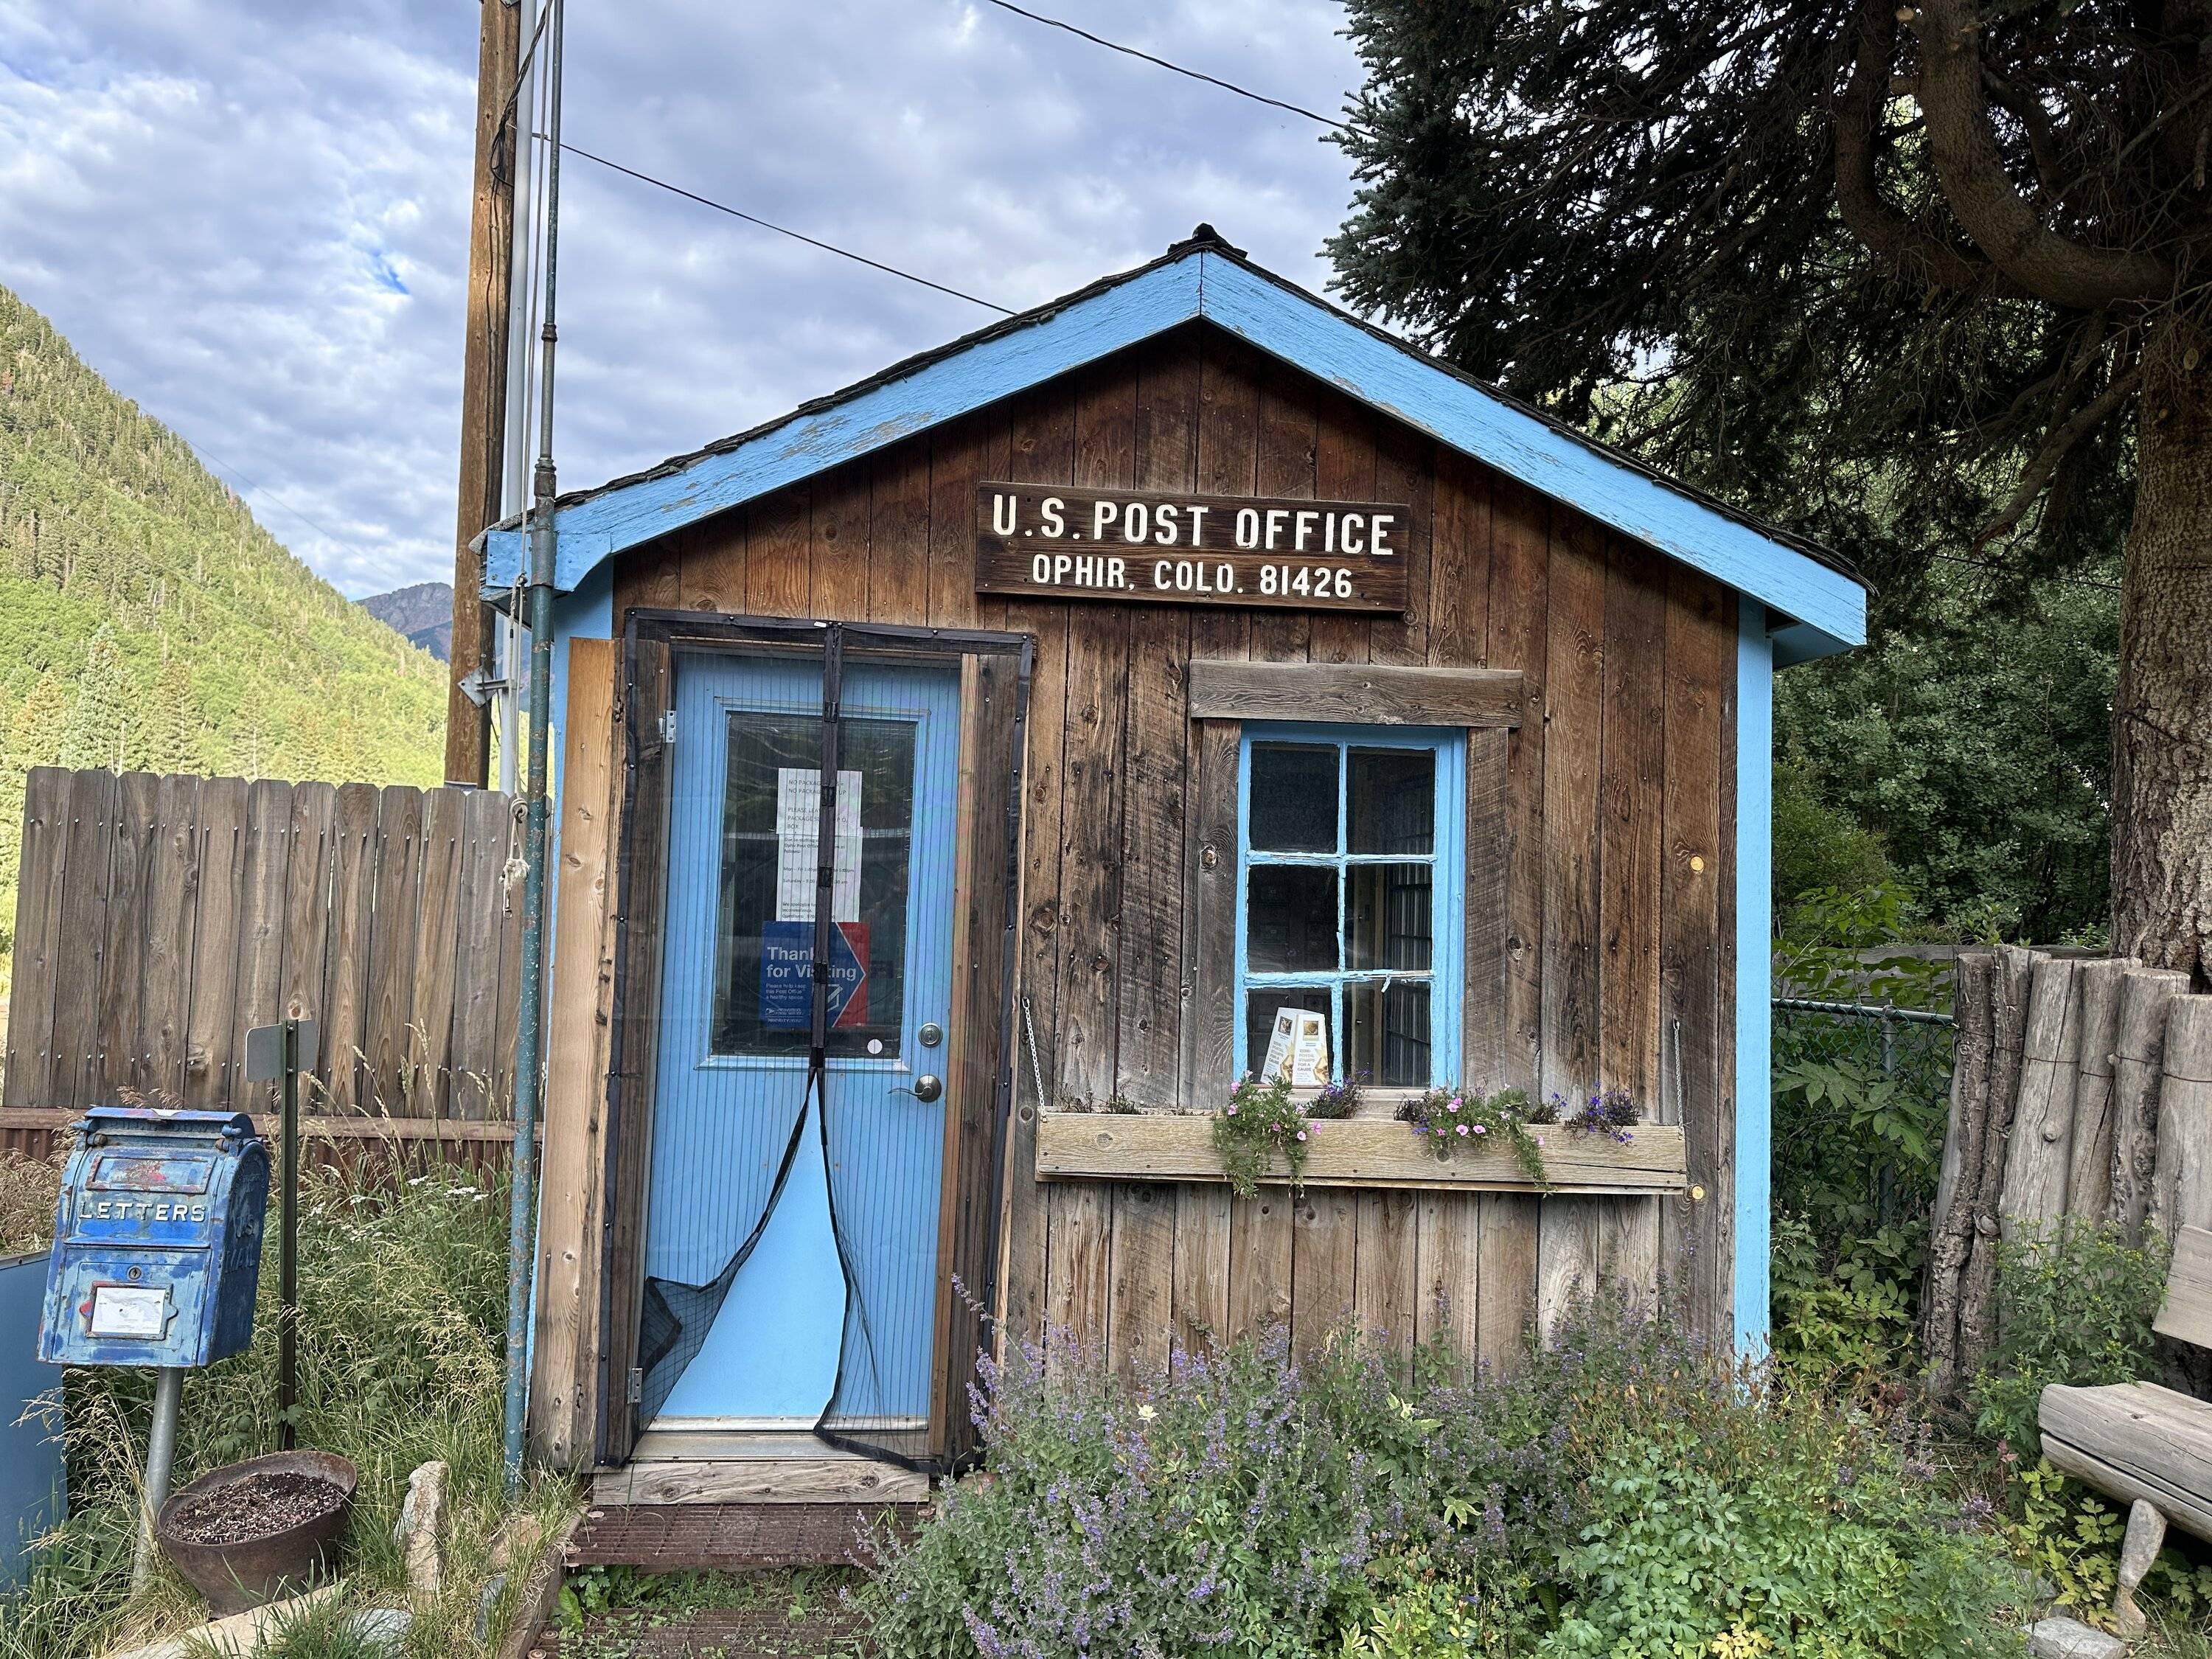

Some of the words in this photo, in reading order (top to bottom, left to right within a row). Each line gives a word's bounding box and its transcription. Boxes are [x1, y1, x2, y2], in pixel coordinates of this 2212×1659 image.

[992, 494, 1081, 540] U.S.
[1093, 501, 1209, 546] POST
[1235, 507, 1395, 555] OFFICE
[1032, 554, 1135, 591] OPHIR,
[1154, 560, 1245, 594] COLO.
[1259, 564, 1353, 599] 81426
[766, 964, 791, 978] for
[78, 1200, 207, 1223] LETTERS
